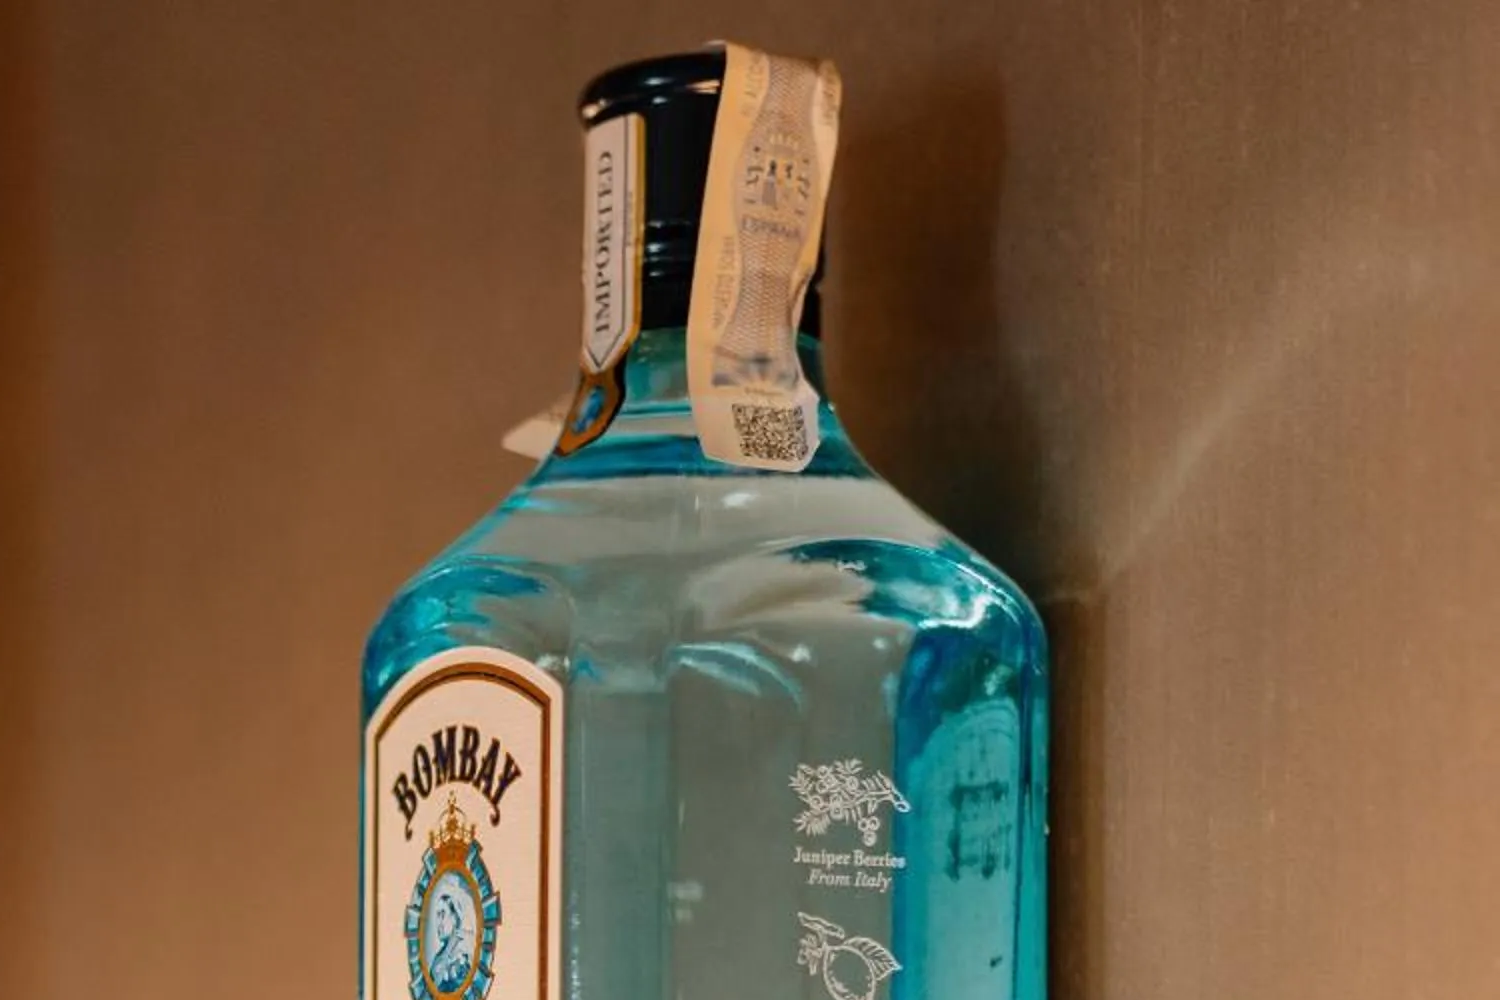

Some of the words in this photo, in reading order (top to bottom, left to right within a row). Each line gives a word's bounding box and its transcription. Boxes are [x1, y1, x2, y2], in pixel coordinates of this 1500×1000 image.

[594, 150, 614, 334] IMPORTED
[392, 724, 522, 841] BOMBAY
[793, 846, 850, 867] Juniper
[853, 849, 906, 869] Berries
[807, 868, 851, 886] From
[854, 871, 893, 892] Italy
